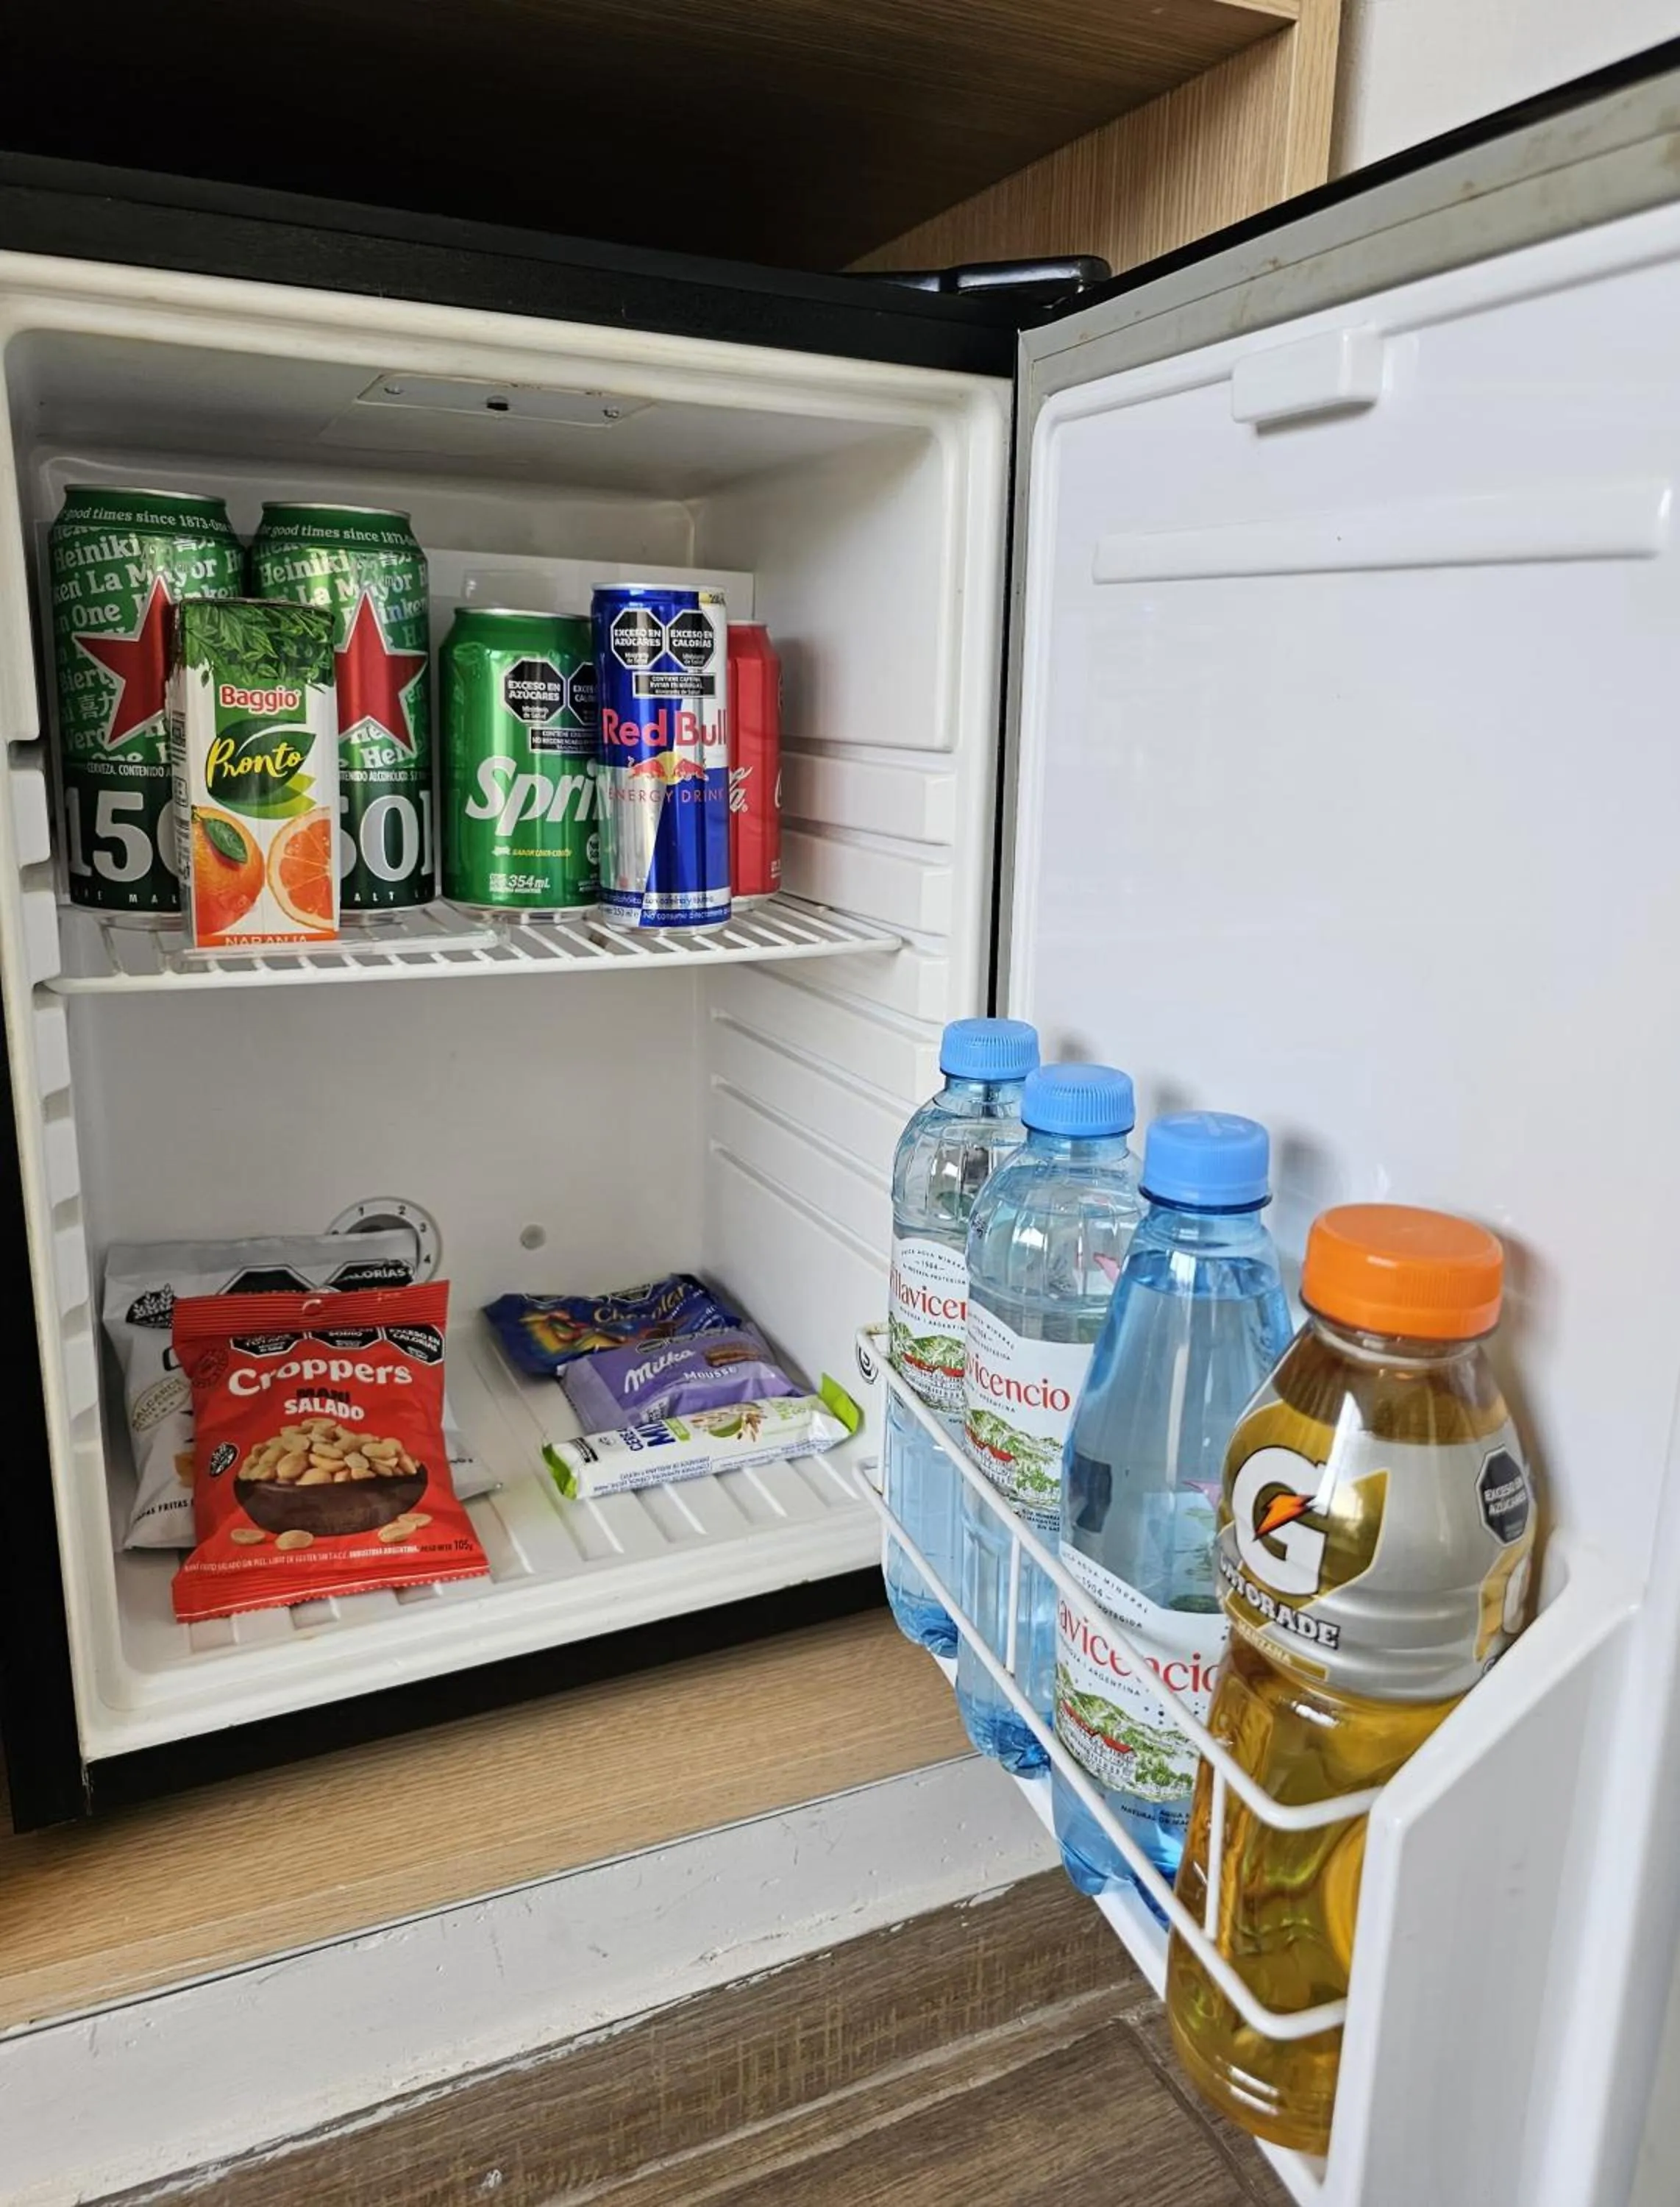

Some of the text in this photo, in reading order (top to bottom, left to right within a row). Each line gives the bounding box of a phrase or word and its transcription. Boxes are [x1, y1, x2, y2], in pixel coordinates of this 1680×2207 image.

[93, 508, 132, 522] times
[136, 511, 177, 525] since
[271, 525, 299, 538] good
[301, 525, 340, 539] times
[344, 527, 379, 542] since
[87, 569, 124, 594] La
[296, 585, 332, 606] La
[72, 603, 122, 626] One
[614, 628, 661, 638] EXCESO EN
[614, 636, 661, 647] AZÚCARES
[670, 629, 713, 639] EXCESO EN
[507, 680, 561, 692] EXCESO EN
[508, 689, 560, 702] AZÚCARES
[221, 685, 299, 713] Baggio
[602, 708, 727, 747] Red Bull
[206, 737, 306, 789] Pronto
[465, 756, 597, 836] Spri
[609, 787, 725, 803] ENERGY DRINK
[228, 1358, 413, 1396] Croppers
[624, 1349, 697, 1393] Milka
[284, 1398, 365, 1421] SALADO
[1484, 1481, 1515, 1502] EXCESO
[1088, 1667, 1141, 1696] ARGENTINA
